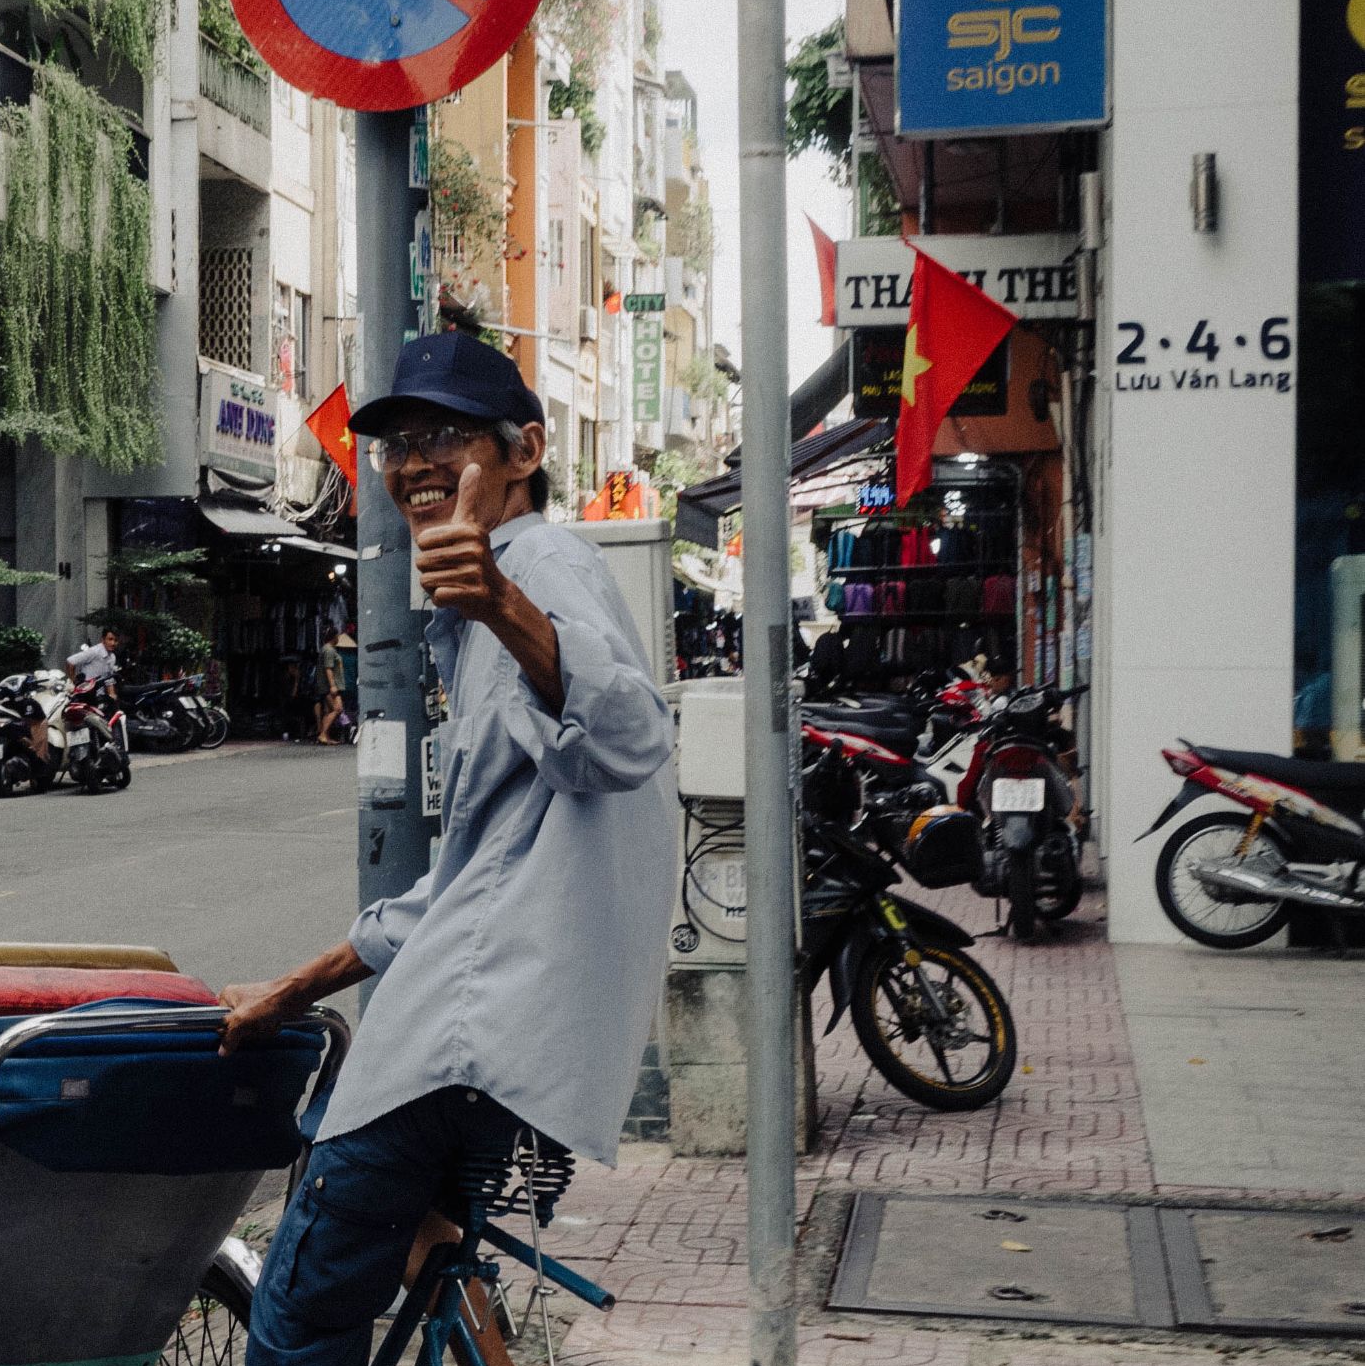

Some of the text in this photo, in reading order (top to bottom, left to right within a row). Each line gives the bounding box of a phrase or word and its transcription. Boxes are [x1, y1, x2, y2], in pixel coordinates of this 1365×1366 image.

[947, 61, 1060, 95] saigon
[626, 295, 664, 312] CITY
[635, 320, 659, 420] HOTEL
[1231, 369, 1291, 393] Lang
